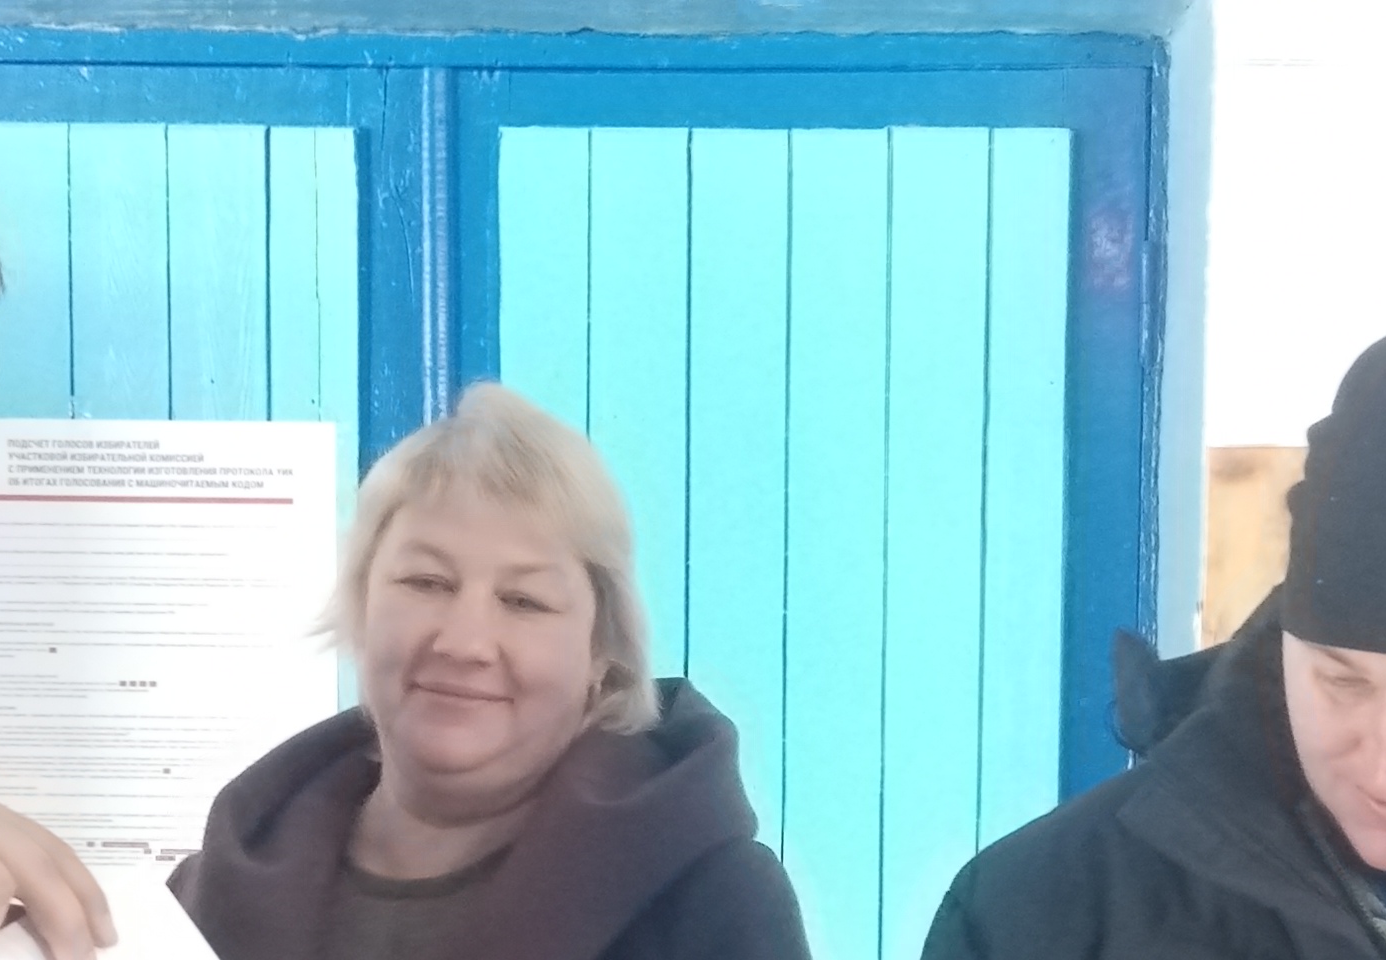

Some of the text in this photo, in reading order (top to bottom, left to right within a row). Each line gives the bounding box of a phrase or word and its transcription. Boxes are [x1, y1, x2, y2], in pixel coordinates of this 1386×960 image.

[7, 439, 160, 450] ПОДСЧЕТ ГОЛОСОВ ИЗБИРАТЕЛЕЙ
[8, 451, 205, 463] УЧАСТКОВОЙ ИЗБИРАТЕЛЬНОЙ КОМИССИЕЙ
[16, 465, 85, 474] ПРИМЕНЕНИЕМ
[87, 466, 146, 475] ТЕХНОЛОГИИ
[147, 467, 217, 476] ИЗГОТОВЛЕНИЯ
[219, 467, 274, 476] ПРОТОКОЛА
[22, 478, 57, 487] ИТОГАХ
[59, 478, 126, 488] ГОЛОСОВАНИЯ
[135, 479, 229, 489] МАШИНОЧИТАЕМЫМ
[231, 481, 264, 490] КОДОМ
